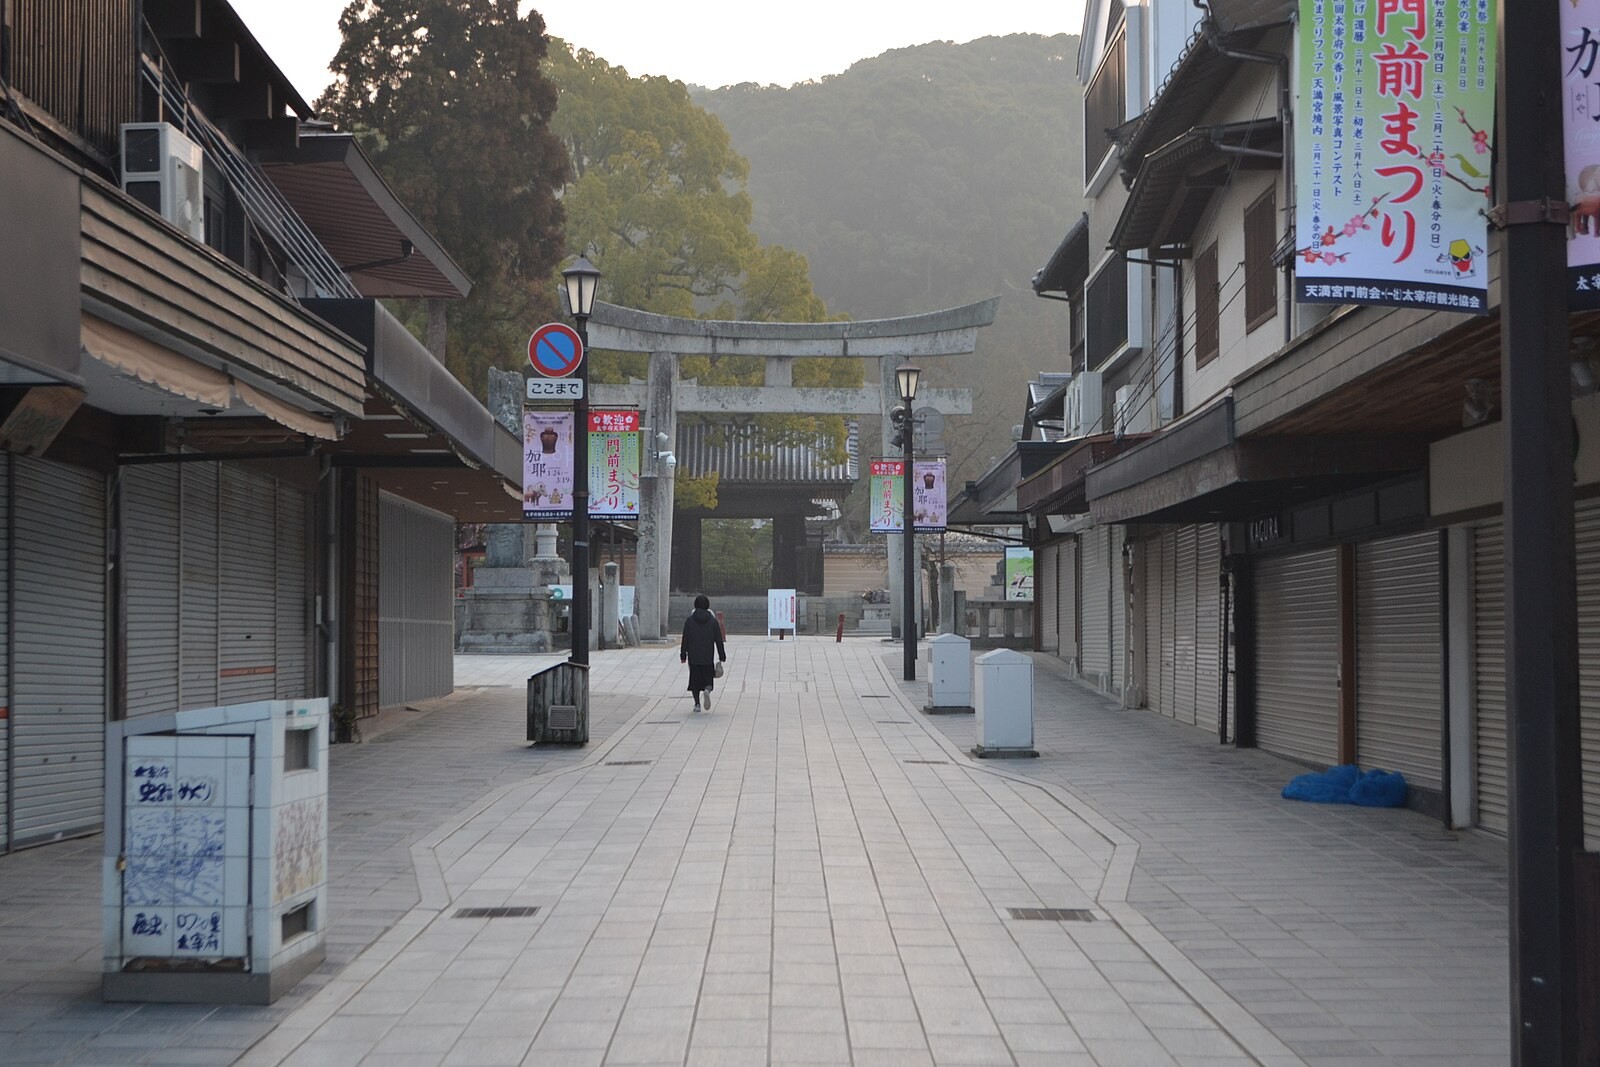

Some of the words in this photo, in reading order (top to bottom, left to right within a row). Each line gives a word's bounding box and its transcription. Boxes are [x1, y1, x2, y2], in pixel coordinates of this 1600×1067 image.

[1312, 0, 1324, 73] まつりフェア
[1353, 20, 1365, 42] 還暦
[1312, 78, 1324, 136] 天満宮境内
[1332, 0, 1344, 197] 回太宰府の香り・風景写真コンテスト
[1353, 116, 1363, 139] 初老
[1373, 0, 1428, 264] 門前まつり
[531, 383, 579, 395] ここまで
[607, 439, 621, 510] 門前まつり
[883, 479, 893, 527] 門前まつり
[1249, 516, 1279, 545] KAGURA
